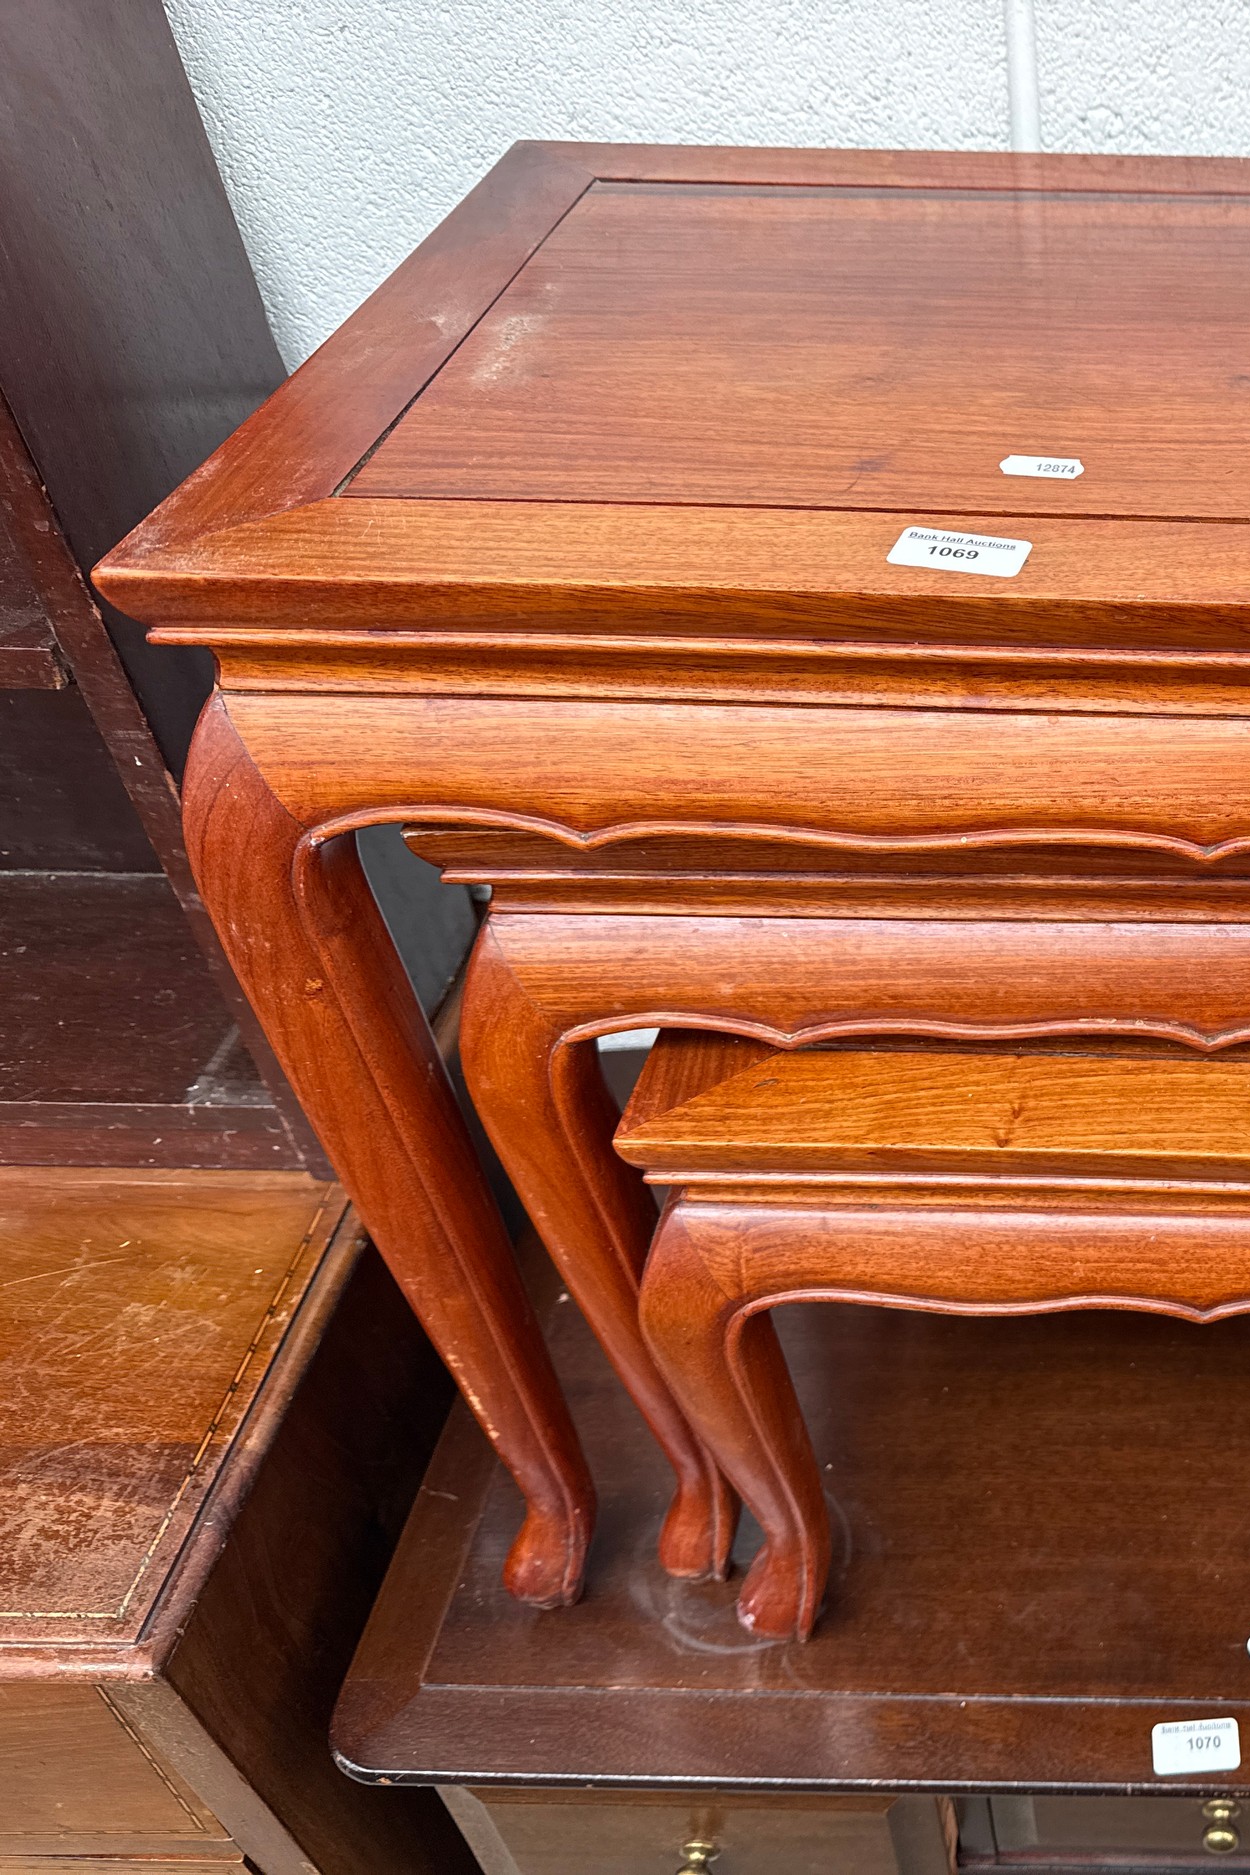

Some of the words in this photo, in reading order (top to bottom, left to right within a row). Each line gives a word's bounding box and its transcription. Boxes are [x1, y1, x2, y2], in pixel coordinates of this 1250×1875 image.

[1036, 463, 1076, 474] 12874
[908, 531, 939, 541] Bank
[941, 535, 964, 544] Hall
[965, 538, 1017, 550] Auctions
[927, 545, 980, 560] 1069
[1187, 1735, 1221, 1750] 1070
